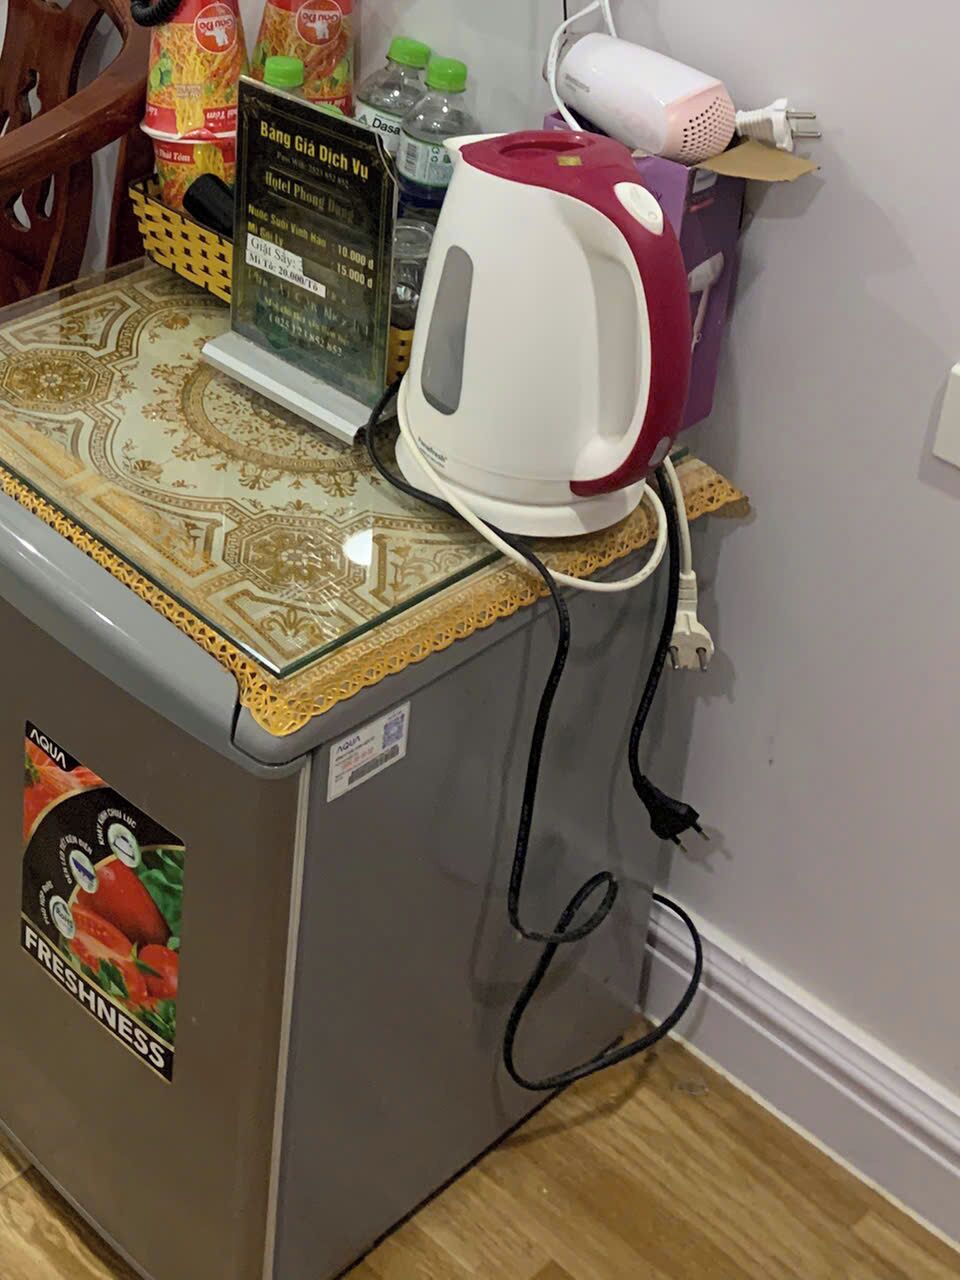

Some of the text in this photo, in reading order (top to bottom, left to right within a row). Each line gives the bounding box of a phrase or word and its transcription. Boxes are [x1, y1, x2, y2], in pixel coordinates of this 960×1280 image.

[372, 117, 401, 136] Dasa
[260, 120, 291, 149] Bảng
[319, 144, 348, 170] Dịch
[352, 157, 369, 183] Vụ
[338, 245, 366, 266] 10.000
[337, 263, 365, 285] 15.000
[30, 729, 68, 769] AQUA
[25, 926, 165, 1069] FRESHNESS
